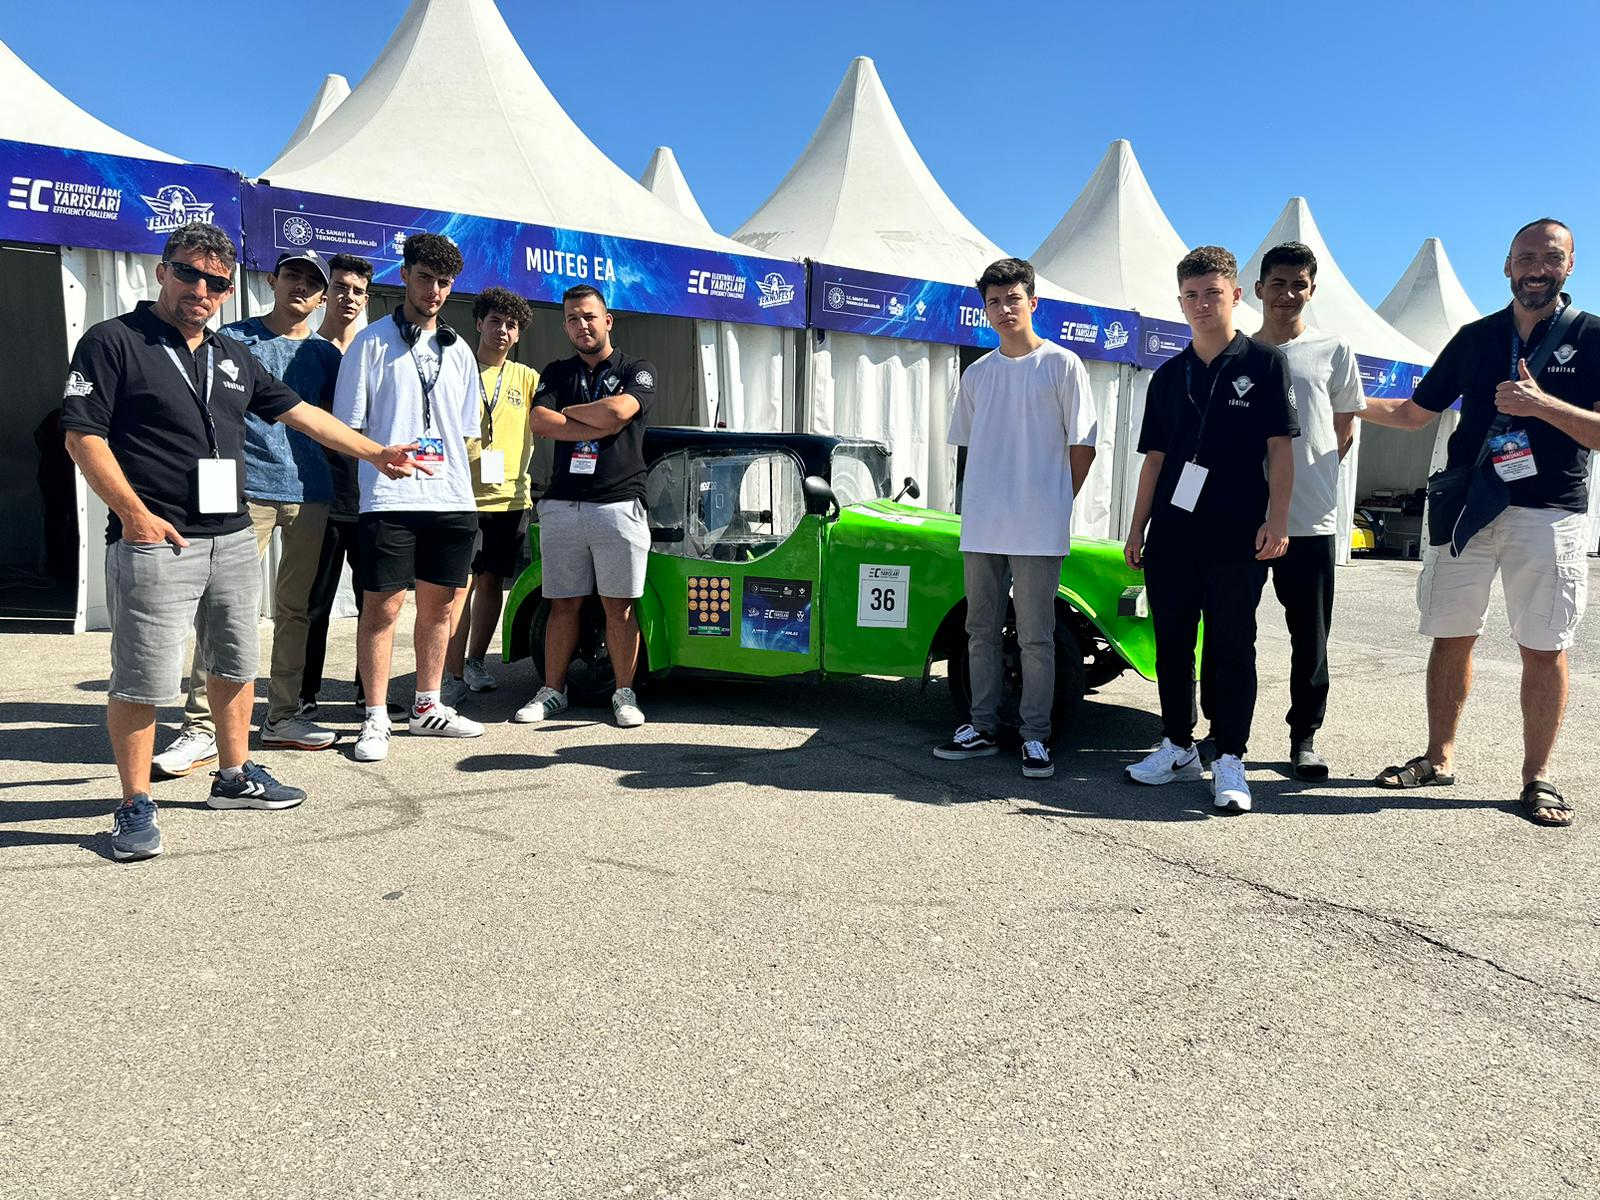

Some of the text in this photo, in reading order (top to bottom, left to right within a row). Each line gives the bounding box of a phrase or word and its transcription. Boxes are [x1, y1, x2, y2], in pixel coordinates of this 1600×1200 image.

[52, 205, 119, 220] EFFICIENCY CHALLENGE
[53, 190, 121, 212] YARIŞLARI
[145, 210, 215, 230] TEKNOFEST
[525, 246, 617, 282] MUTEG EA
[959, 305, 992, 329] TECH
[870, 587, 896, 611] 36
